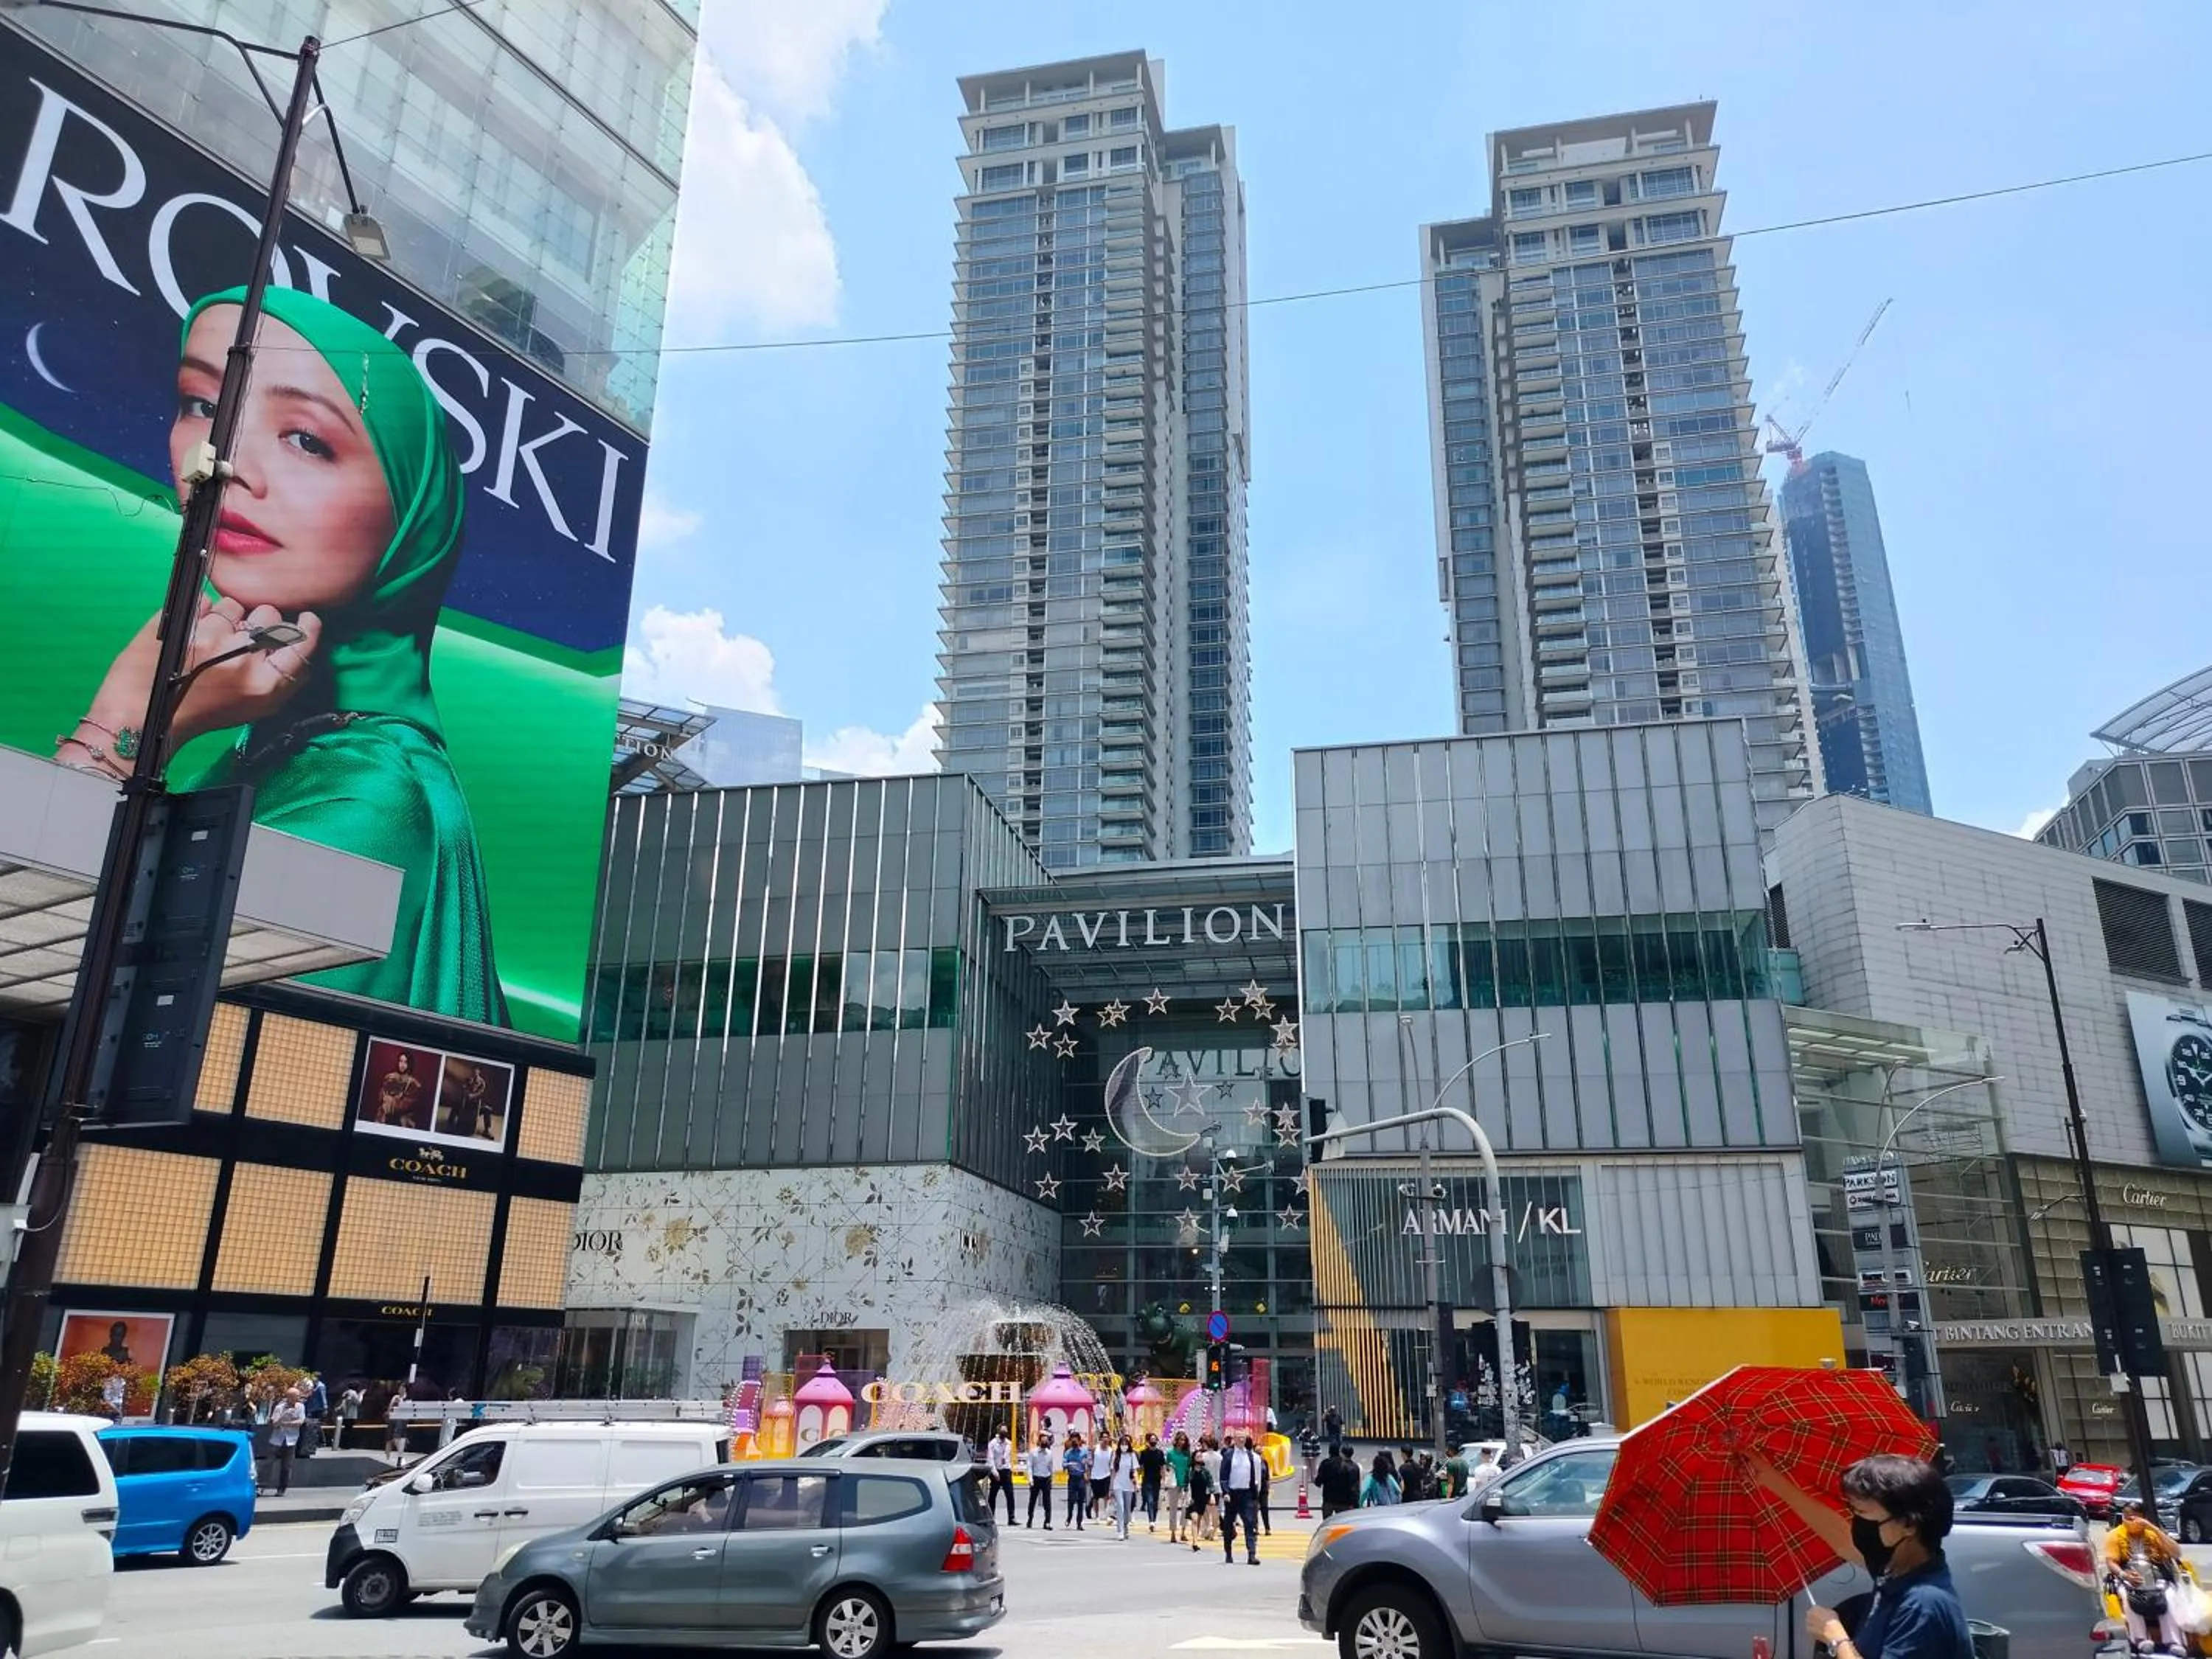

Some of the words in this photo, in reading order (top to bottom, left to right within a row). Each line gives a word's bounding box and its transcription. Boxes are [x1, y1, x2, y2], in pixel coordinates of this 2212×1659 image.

[1004, 904, 1285, 953] PAVILION
[389, 1158, 467, 1179] COACH
[2124, 1182, 2167, 1207] Cartier
[1539, 1207, 1582, 1234] KL
[1946, 1325, 2019, 1340] BINTANG
[860, 1381, 1023, 1403] COACH
